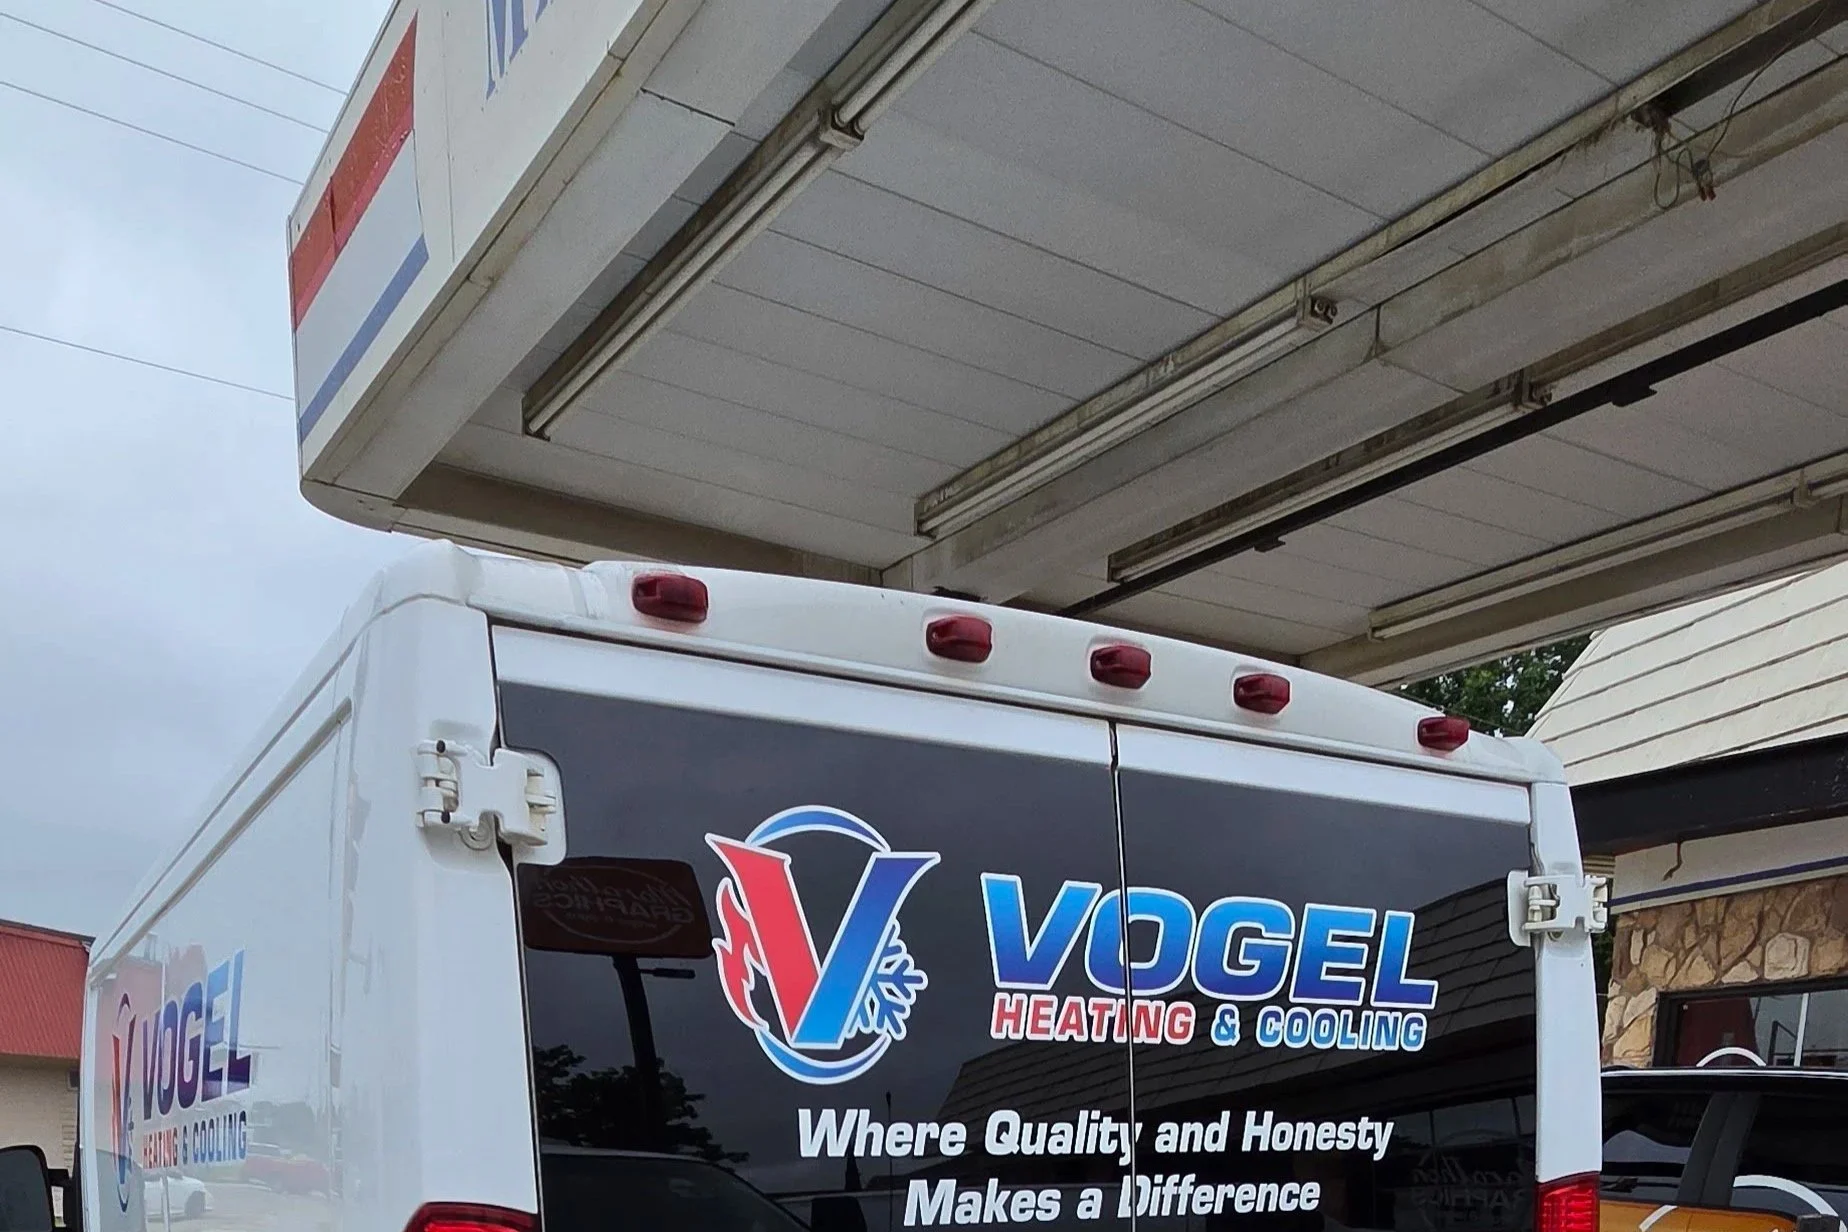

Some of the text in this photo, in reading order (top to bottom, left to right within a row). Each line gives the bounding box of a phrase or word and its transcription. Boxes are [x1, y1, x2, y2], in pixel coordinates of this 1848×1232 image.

[980, 873, 1438, 1010] VOGEL
[142, 949, 251, 1120] VOGEL
[991, 993, 1428, 1051] HEATING & COOLING
[142, 1127, 178, 1170] HEATING
[192, 1110, 247, 1164] COOLING
[798, 1108, 1394, 1166] Where Quality and Honesty
[903, 1173, 1321, 1227] Makes a Difference
